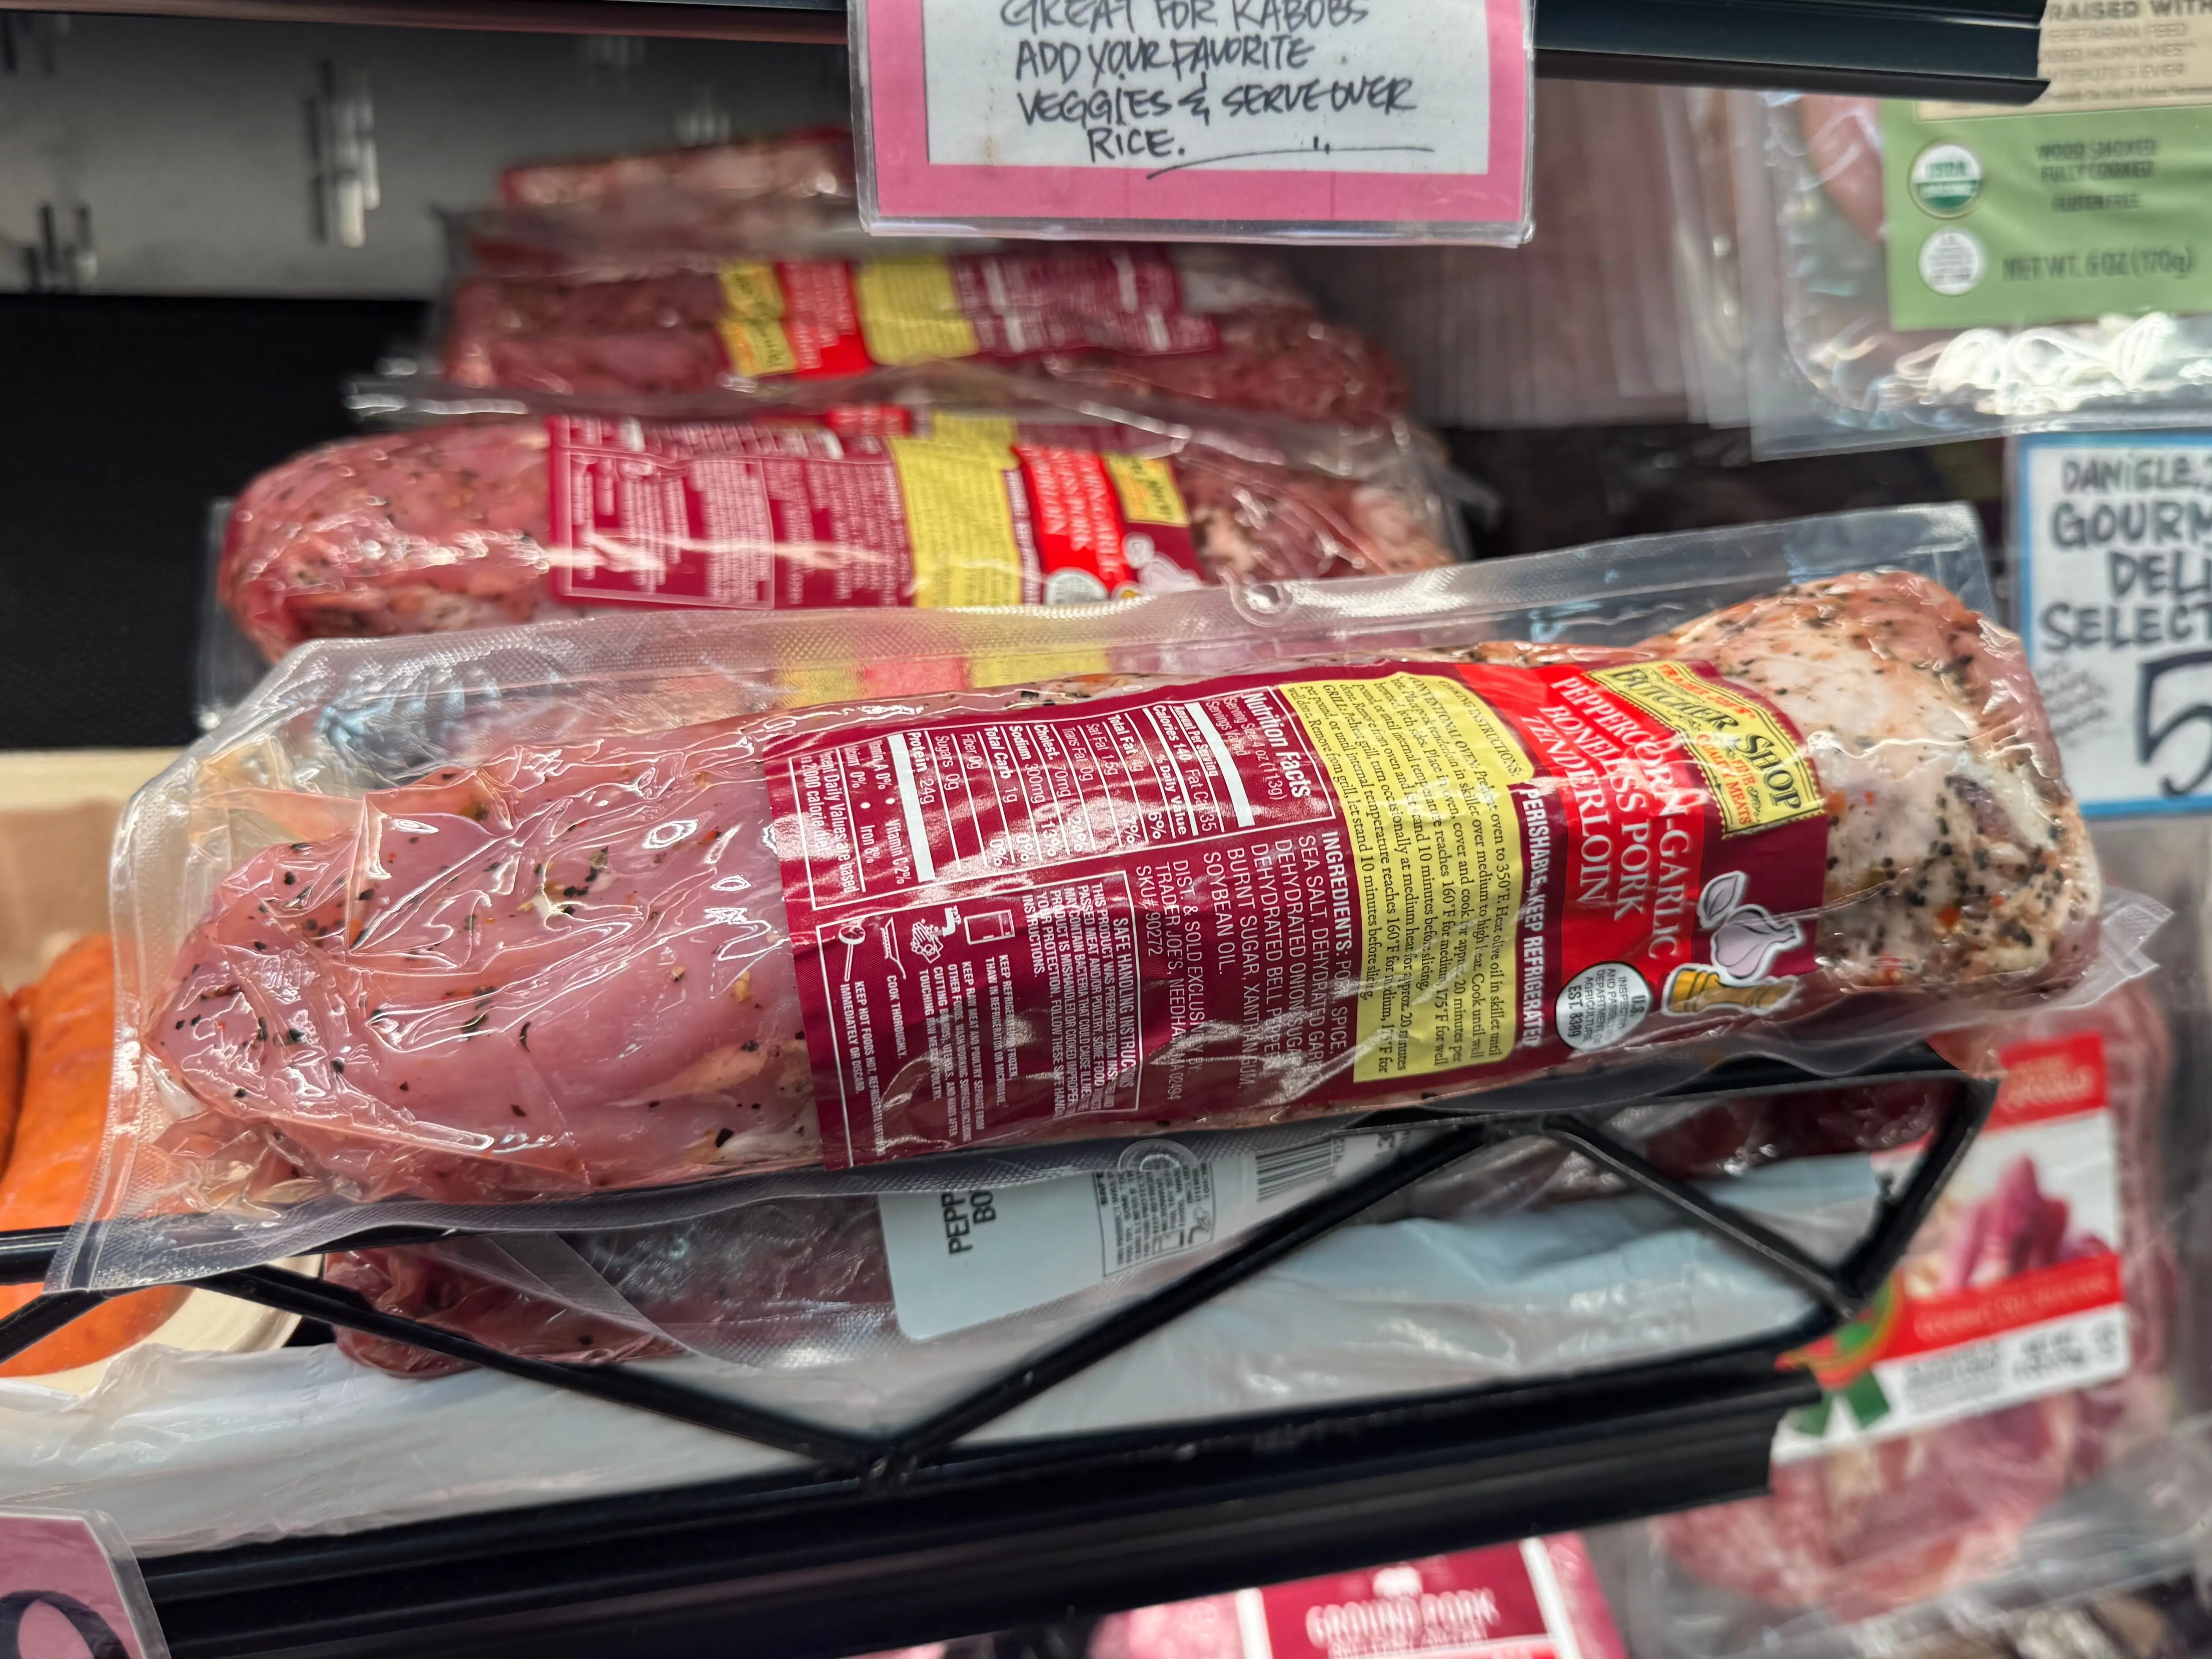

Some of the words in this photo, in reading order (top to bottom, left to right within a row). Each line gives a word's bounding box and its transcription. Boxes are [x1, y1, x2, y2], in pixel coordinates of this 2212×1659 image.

[1157, 0, 1217, 32] FOR
[1232, 0, 1368, 31] KABOBS
[1015, 39, 1080, 84] ADD
[1087, 38, 1167, 80] YOUR
[1171, 35, 1314, 80] FAVORITE
[1018, 90, 1171, 127] VEGGIES
[1222, 81, 1321, 117] SERVE
[1331, 75, 1418, 116] OVER
[1087, 129, 1185, 162] RICE.
[1107, 715, 1130, 735] Total
[1223, 697, 1247, 723] Serving
[983, 726, 1006, 751] Total
[1117, 736, 1136, 755] Fat
[1241, 723, 1258, 740] Size
[1241, 692, 1289, 747] Nutrition
[1275, 752, 1312, 798] Facts
[1612, 668, 1739, 732] BUTCHER
[1735, 734, 1802, 809] SHOP
[906, 731, 930, 772] Protein
[918, 779, 938, 804] 24g
[932, 735, 954, 768] Sugars
[945, 773, 961, 790] 0g
[993, 752, 1014, 779] Carb
[1008, 725, 1034, 760] Sodium
[1024, 763, 1048, 804] 300mg
[1032, 724, 1061, 760] Cholest.
[1053, 765, 1074, 798] 70mg
[1151, 705, 1180, 741] Calories
[1171, 743, 1193, 760] 140
[1185, 769, 1203, 788] Fat
[1199, 814, 1217, 831] 35
[1255, 750, 1269, 761] oz
[1001, 786, 1020, 803] 1g
[1159, 765, 1176, 792] Daily
[1170, 795, 1188, 835] Value
[1258, 763, 1288, 800] (113g)
[1520, 716, 1612, 904] TENDERLOIN
[1537, 704, 1647, 812] BONELESS
[1613, 821, 1650, 921] PORK
[1725, 782, 1752, 825] MEATS
[1147, 812, 1167, 839] 6%
[1490, 814, 1504, 845] oven
[1016, 834, 1037, 862] 0%
[1298, 835, 1318, 871] SEA
[1496, 848, 1506, 861] to
[1135, 865, 1160, 909] SKU#
[1154, 862, 1179, 926] TRADER
[1172, 860, 1195, 900] DIST.
[1203, 851, 1234, 937] SOYBEAN
[1227, 847, 1255, 909] BURNT
[1321, 831, 1353, 956] INGREDIENTS:
[1497, 864, 1510, 903] 350°F.
[1183, 905, 1198, 916] &
[1251, 843, 1283, 962] DEHYDRATED
[1274, 839, 1306, 957] DEHYDRATED
[1306, 875, 1328, 923] SALT,
[1523, 894, 1545, 931] KEEP
[1113, 917, 1132, 951] SAFE
[1145, 913, 1164, 956] 90272
[1493, 906, 1508, 932] Heat
[1165, 930, 1183, 975] JOE'S,
[1184, 922, 1202, 961] SOLD
[1217, 943, 1236, 974] OIL.
[1239, 915, 1260, 980] SUGAR,
[1490, 935, 1504, 960] olive
[886, 975, 898, 1001] COOK
[1116, 954, 1134, 1013] HANDLING
[1266, 967, 1283, 1004] BELL
[1309, 929, 1329, 1026] DEHYDRATED
[1490, 963, 1505, 978] oil
[1490, 981, 1504, 993] in
[854, 981, 866, 1006] KEEP
[1522, 936, 1542, 1047] REFRIGERATED
[1568, 985, 1582, 1009] EST.
[839, 983, 856, 1044] IMMEDIATELY
[856, 1008, 867, 1026] HOT
[891, 1003, 907, 1059] THOROUGHLY.
[1242, 983, 1260, 1052] XANTHAN
[1329, 1006, 1348, 1054] SPICE,
[1490, 996, 1505, 1030] skillet
[848, 1047, 859, 1059] OR
[859, 1029, 872, 1055] FOODS
[1489, 1033, 1501, 1055] until
[851, 1060, 865, 1094] DISCARD.
[865, 1058, 876, 1074] HOT.
[1238, 1058, 1258, 1089] GUM,
[868, 1075, 881, 1121] REFRIGERATE
[1167, 1073, 1183, 1100] 02494
[941, 1192, 973, 1255] PEPP
